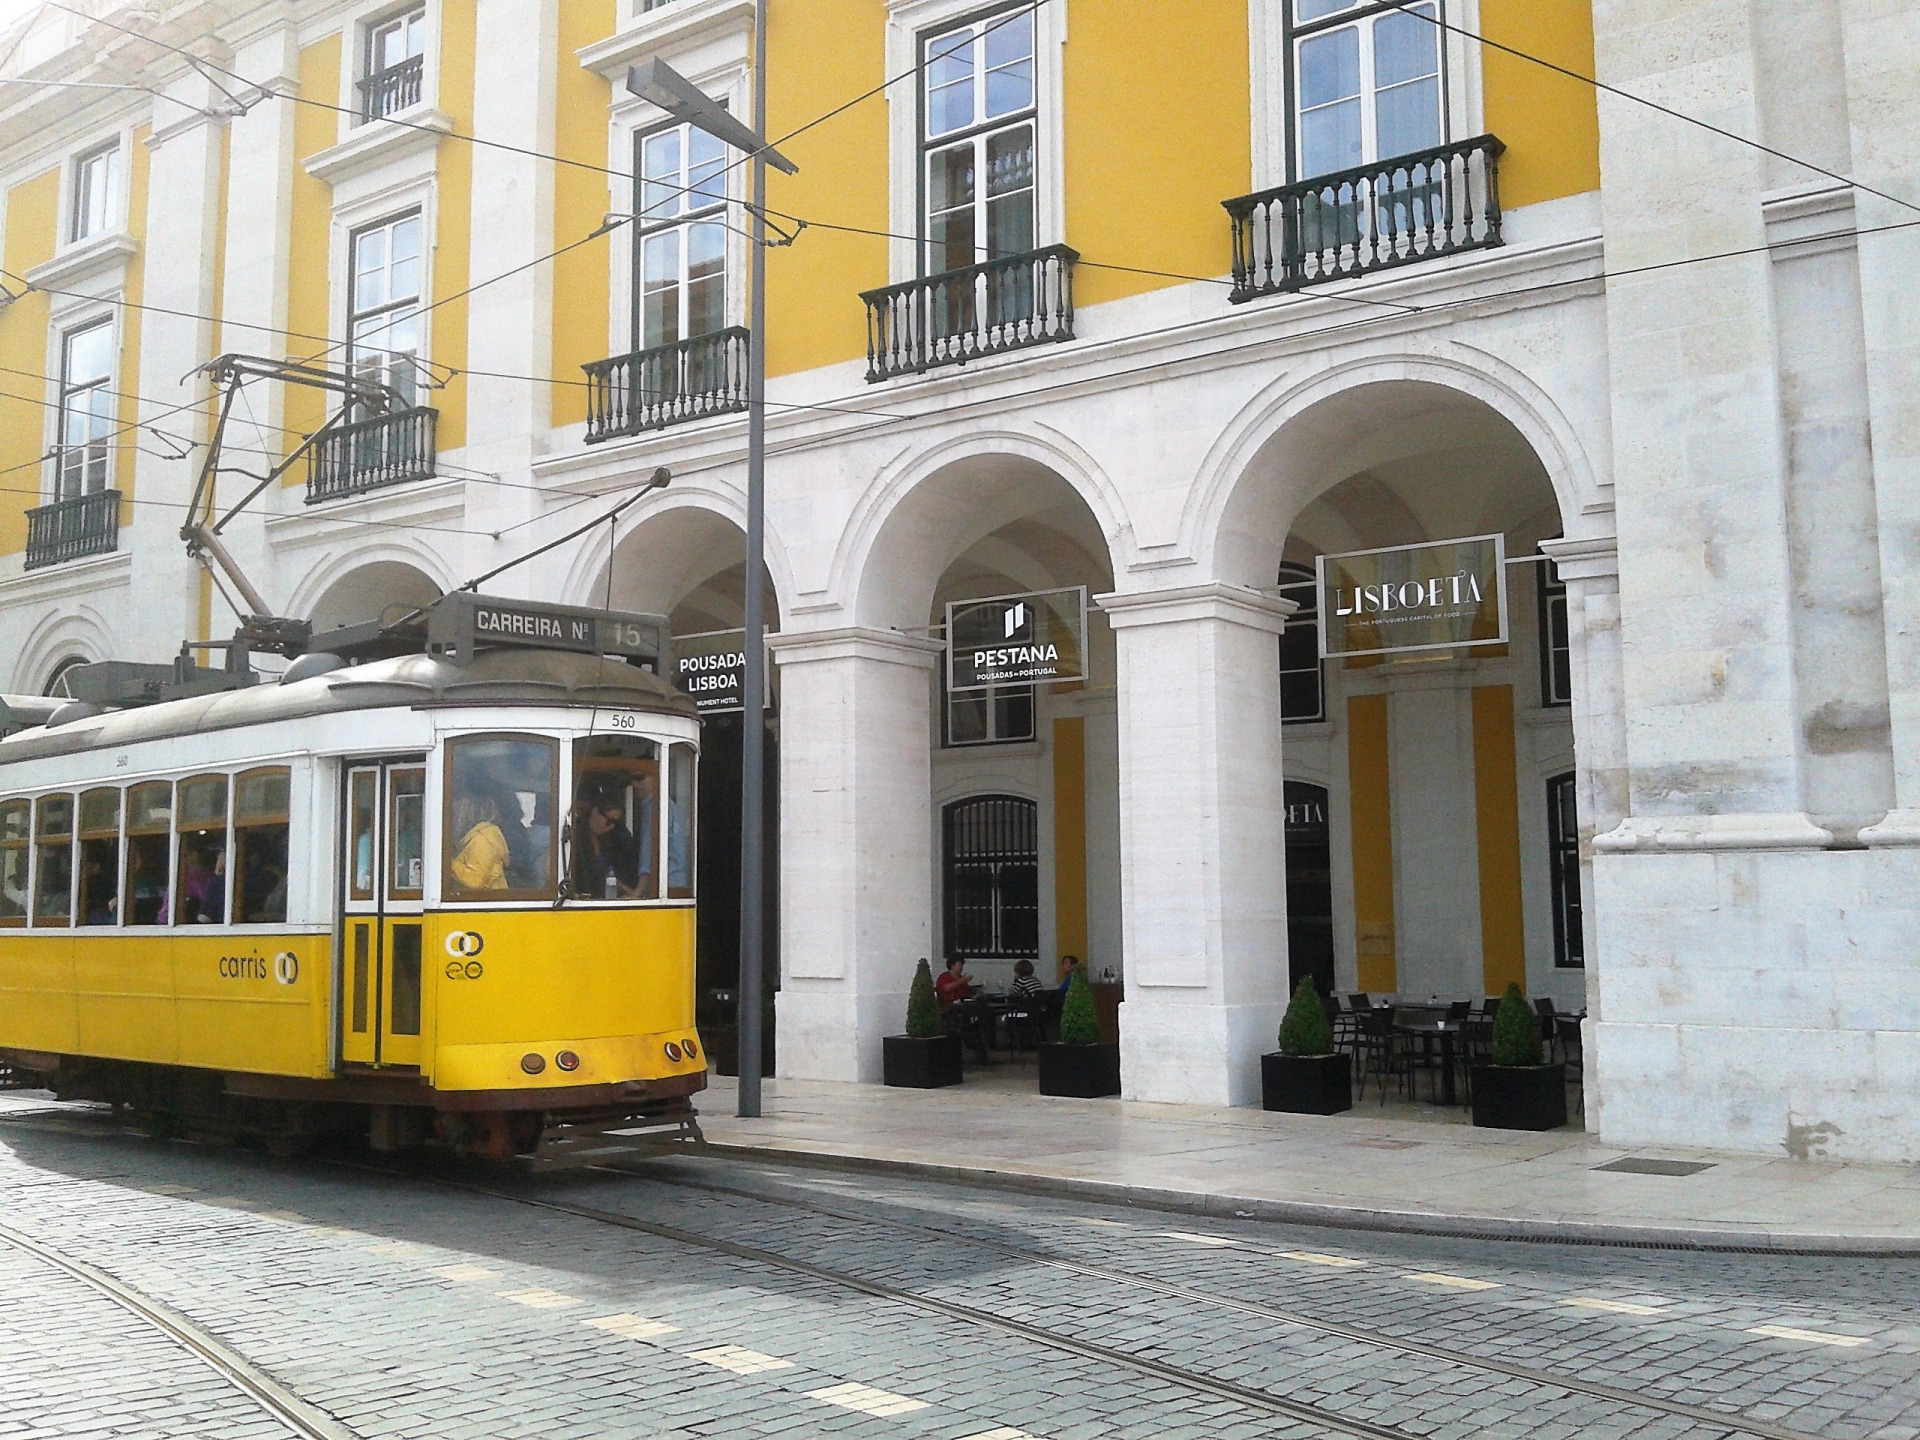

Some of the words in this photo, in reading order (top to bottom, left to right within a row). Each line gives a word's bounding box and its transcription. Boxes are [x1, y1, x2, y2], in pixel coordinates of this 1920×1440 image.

[1336, 569, 1483, 616] LISBOETA
[477, 610, 563, 638] CARREIRA
[614, 623, 641, 647] 15
[680, 652, 746, 673] POUSADA
[974, 643, 1059, 668] PESTANA
[688, 673, 738, 692] LISBOA
[976, 670, 1014, 681] POUSADAS
[1019, 667, 1058, 677] PORTUGAL
[720, 696, 739, 704] HOTEL
[612, 714, 636, 728] 560
[219, 948, 267, 979] carris
